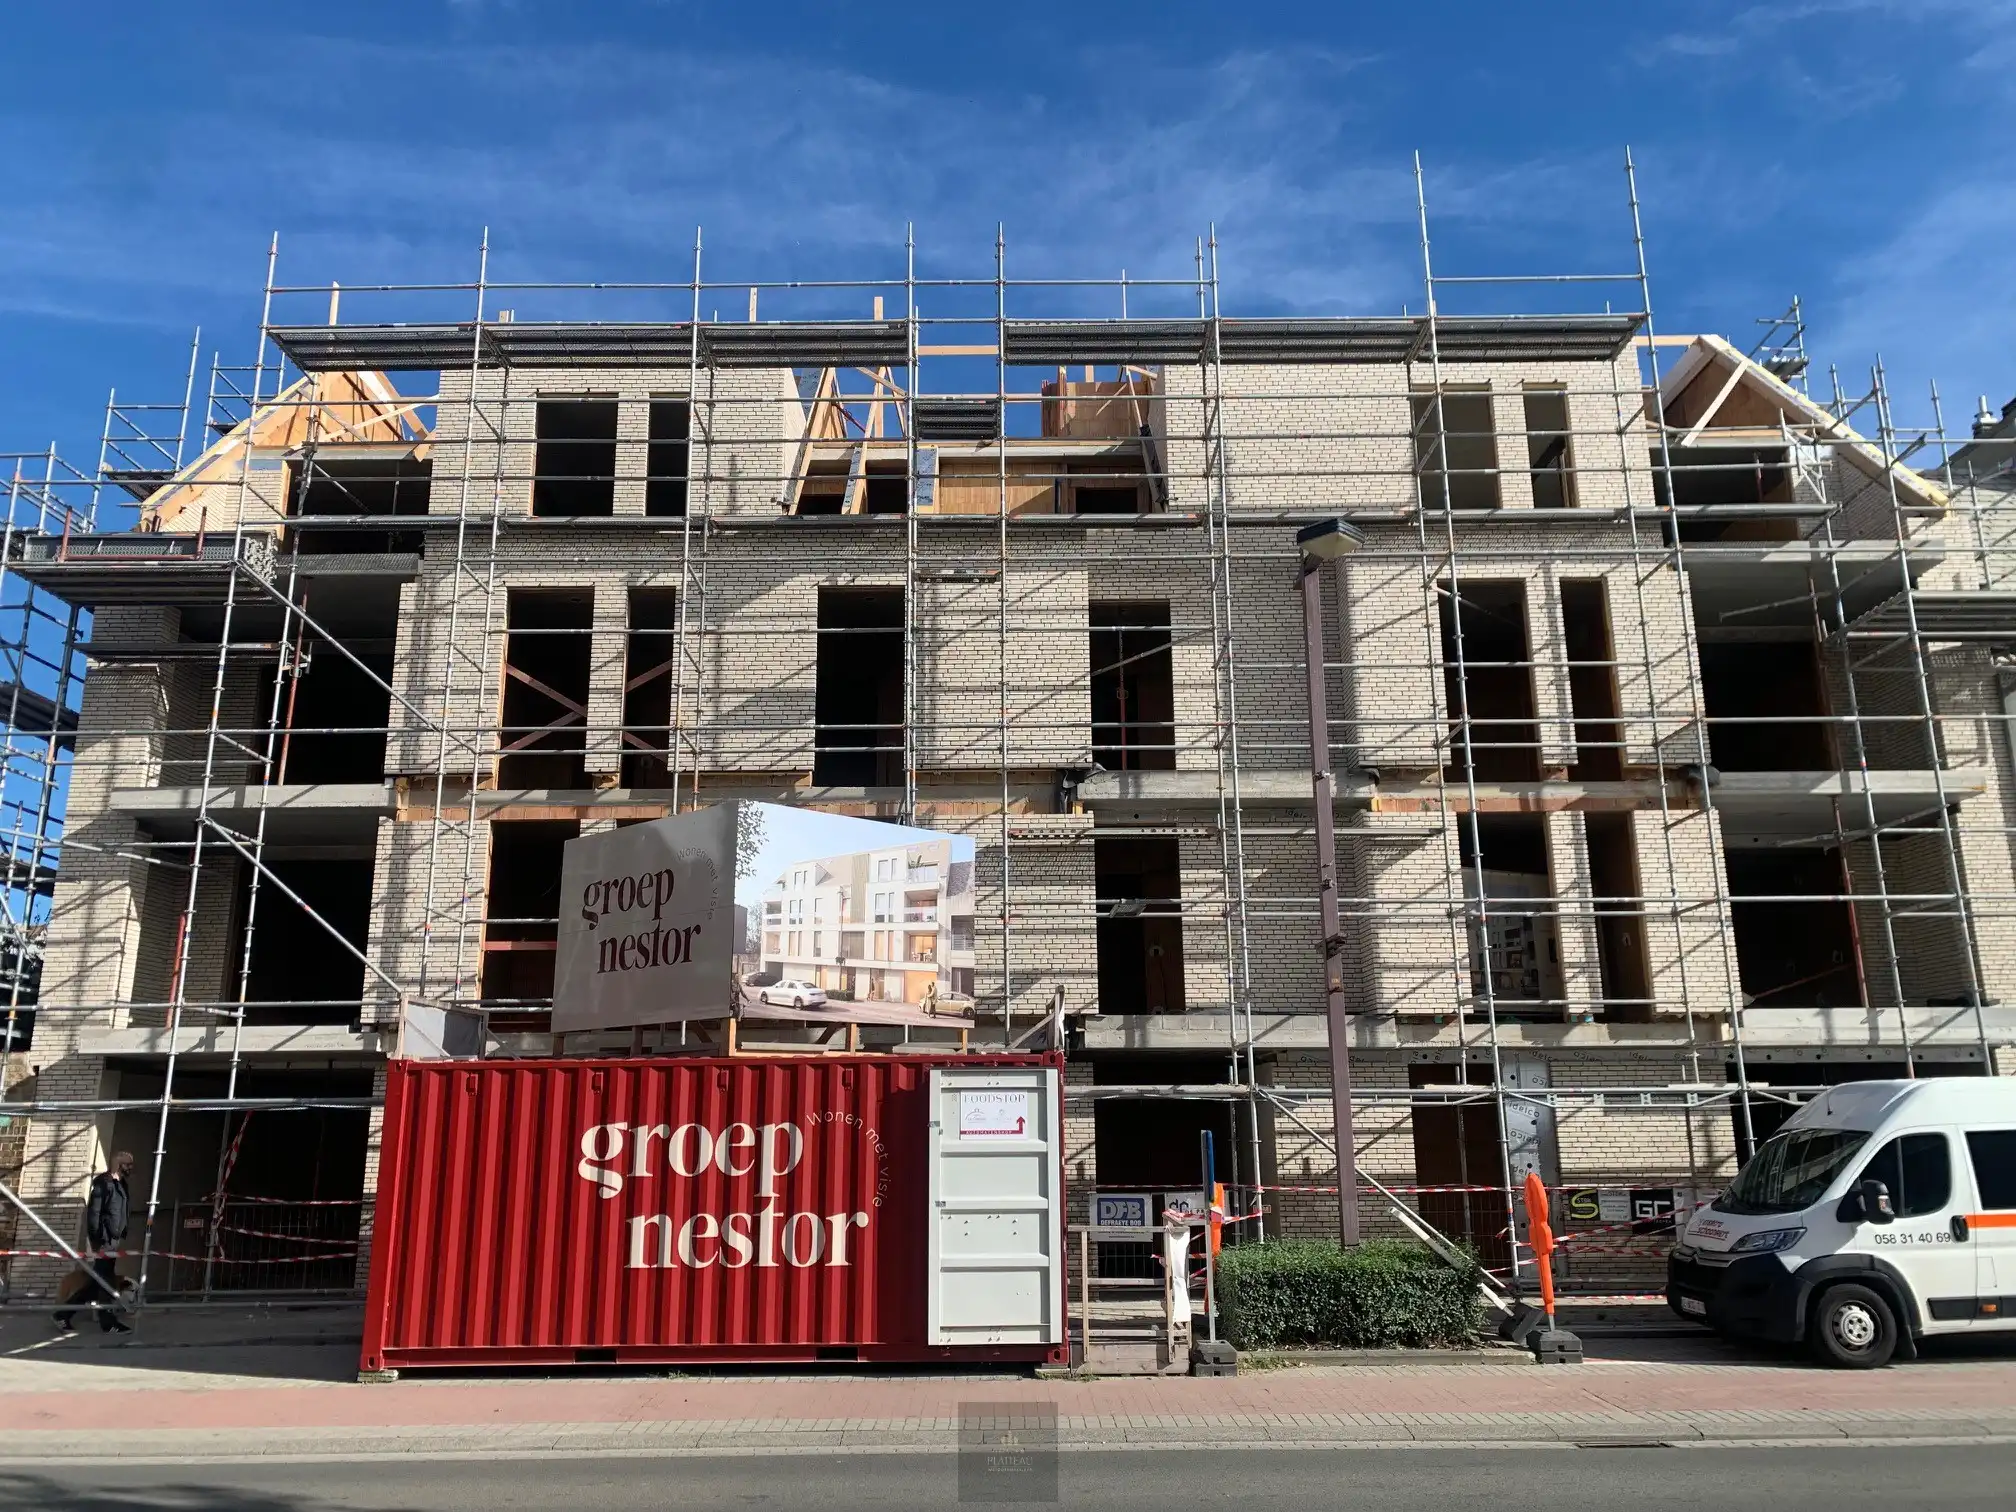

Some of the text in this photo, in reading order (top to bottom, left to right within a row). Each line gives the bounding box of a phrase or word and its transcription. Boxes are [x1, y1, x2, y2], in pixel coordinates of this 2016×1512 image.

[676, 846, 706, 861] Wonen
[582, 867, 675, 931] groep
[596, 919, 702, 974] nestor
[963, 1093, 1025, 1103] FOODSTOP
[1509, 1101, 1540, 1118] idelco
[578, 1121, 804, 1200] groep
[806, 1110, 893, 1208] Wonen met visie
[1100, 1201, 1142, 1219] DFB
[623, 1196, 870, 1269] nestor
[1874, 1232, 1951, 1244] 058 31 40 69
